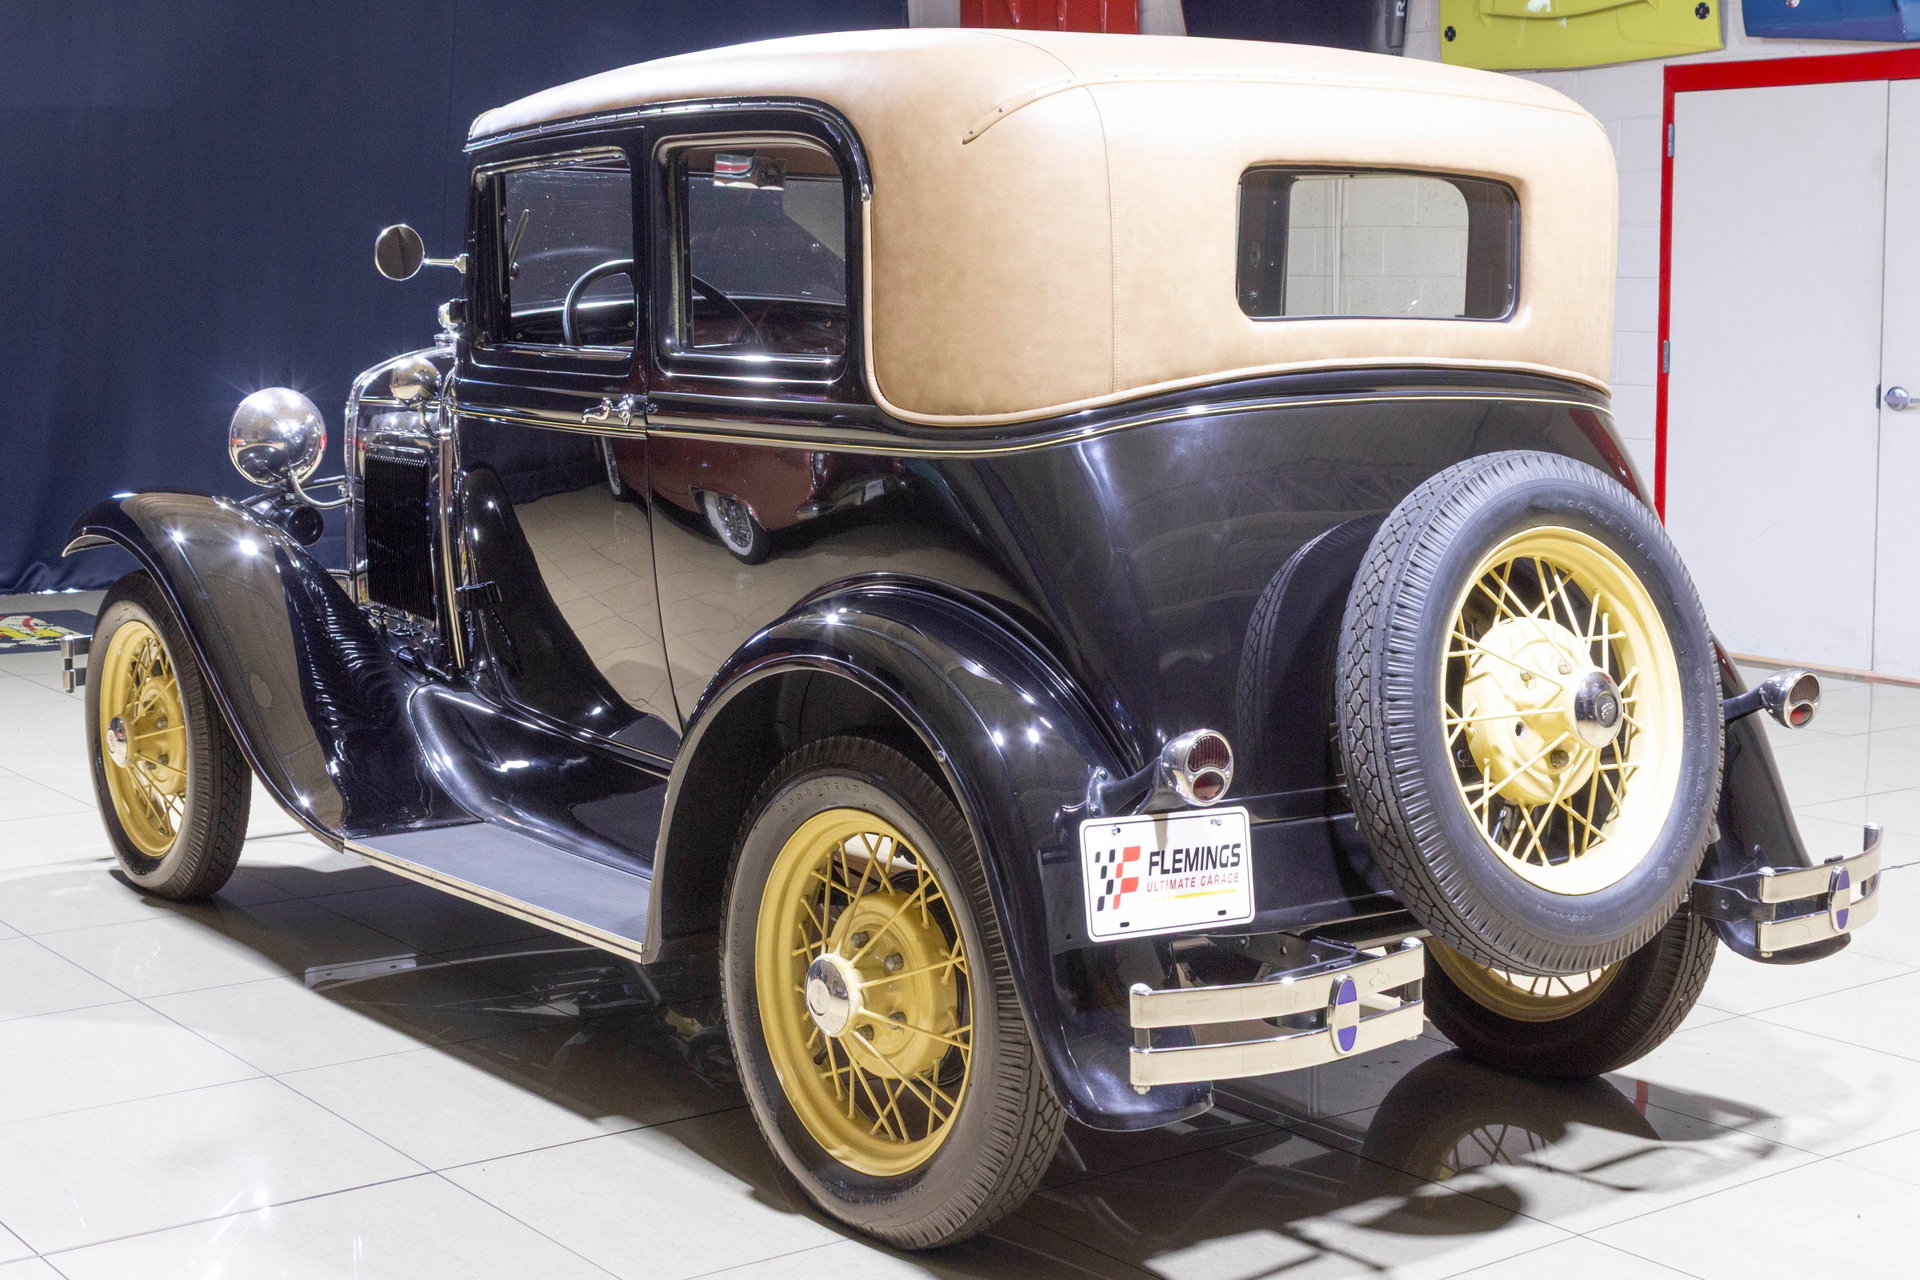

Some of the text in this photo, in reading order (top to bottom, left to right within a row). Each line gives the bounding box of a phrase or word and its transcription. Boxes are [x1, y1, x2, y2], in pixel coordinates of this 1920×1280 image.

[1148, 843, 1241, 876] FLEMINGS
[1146, 872, 1240, 892] ULTIMATE GARAGE
